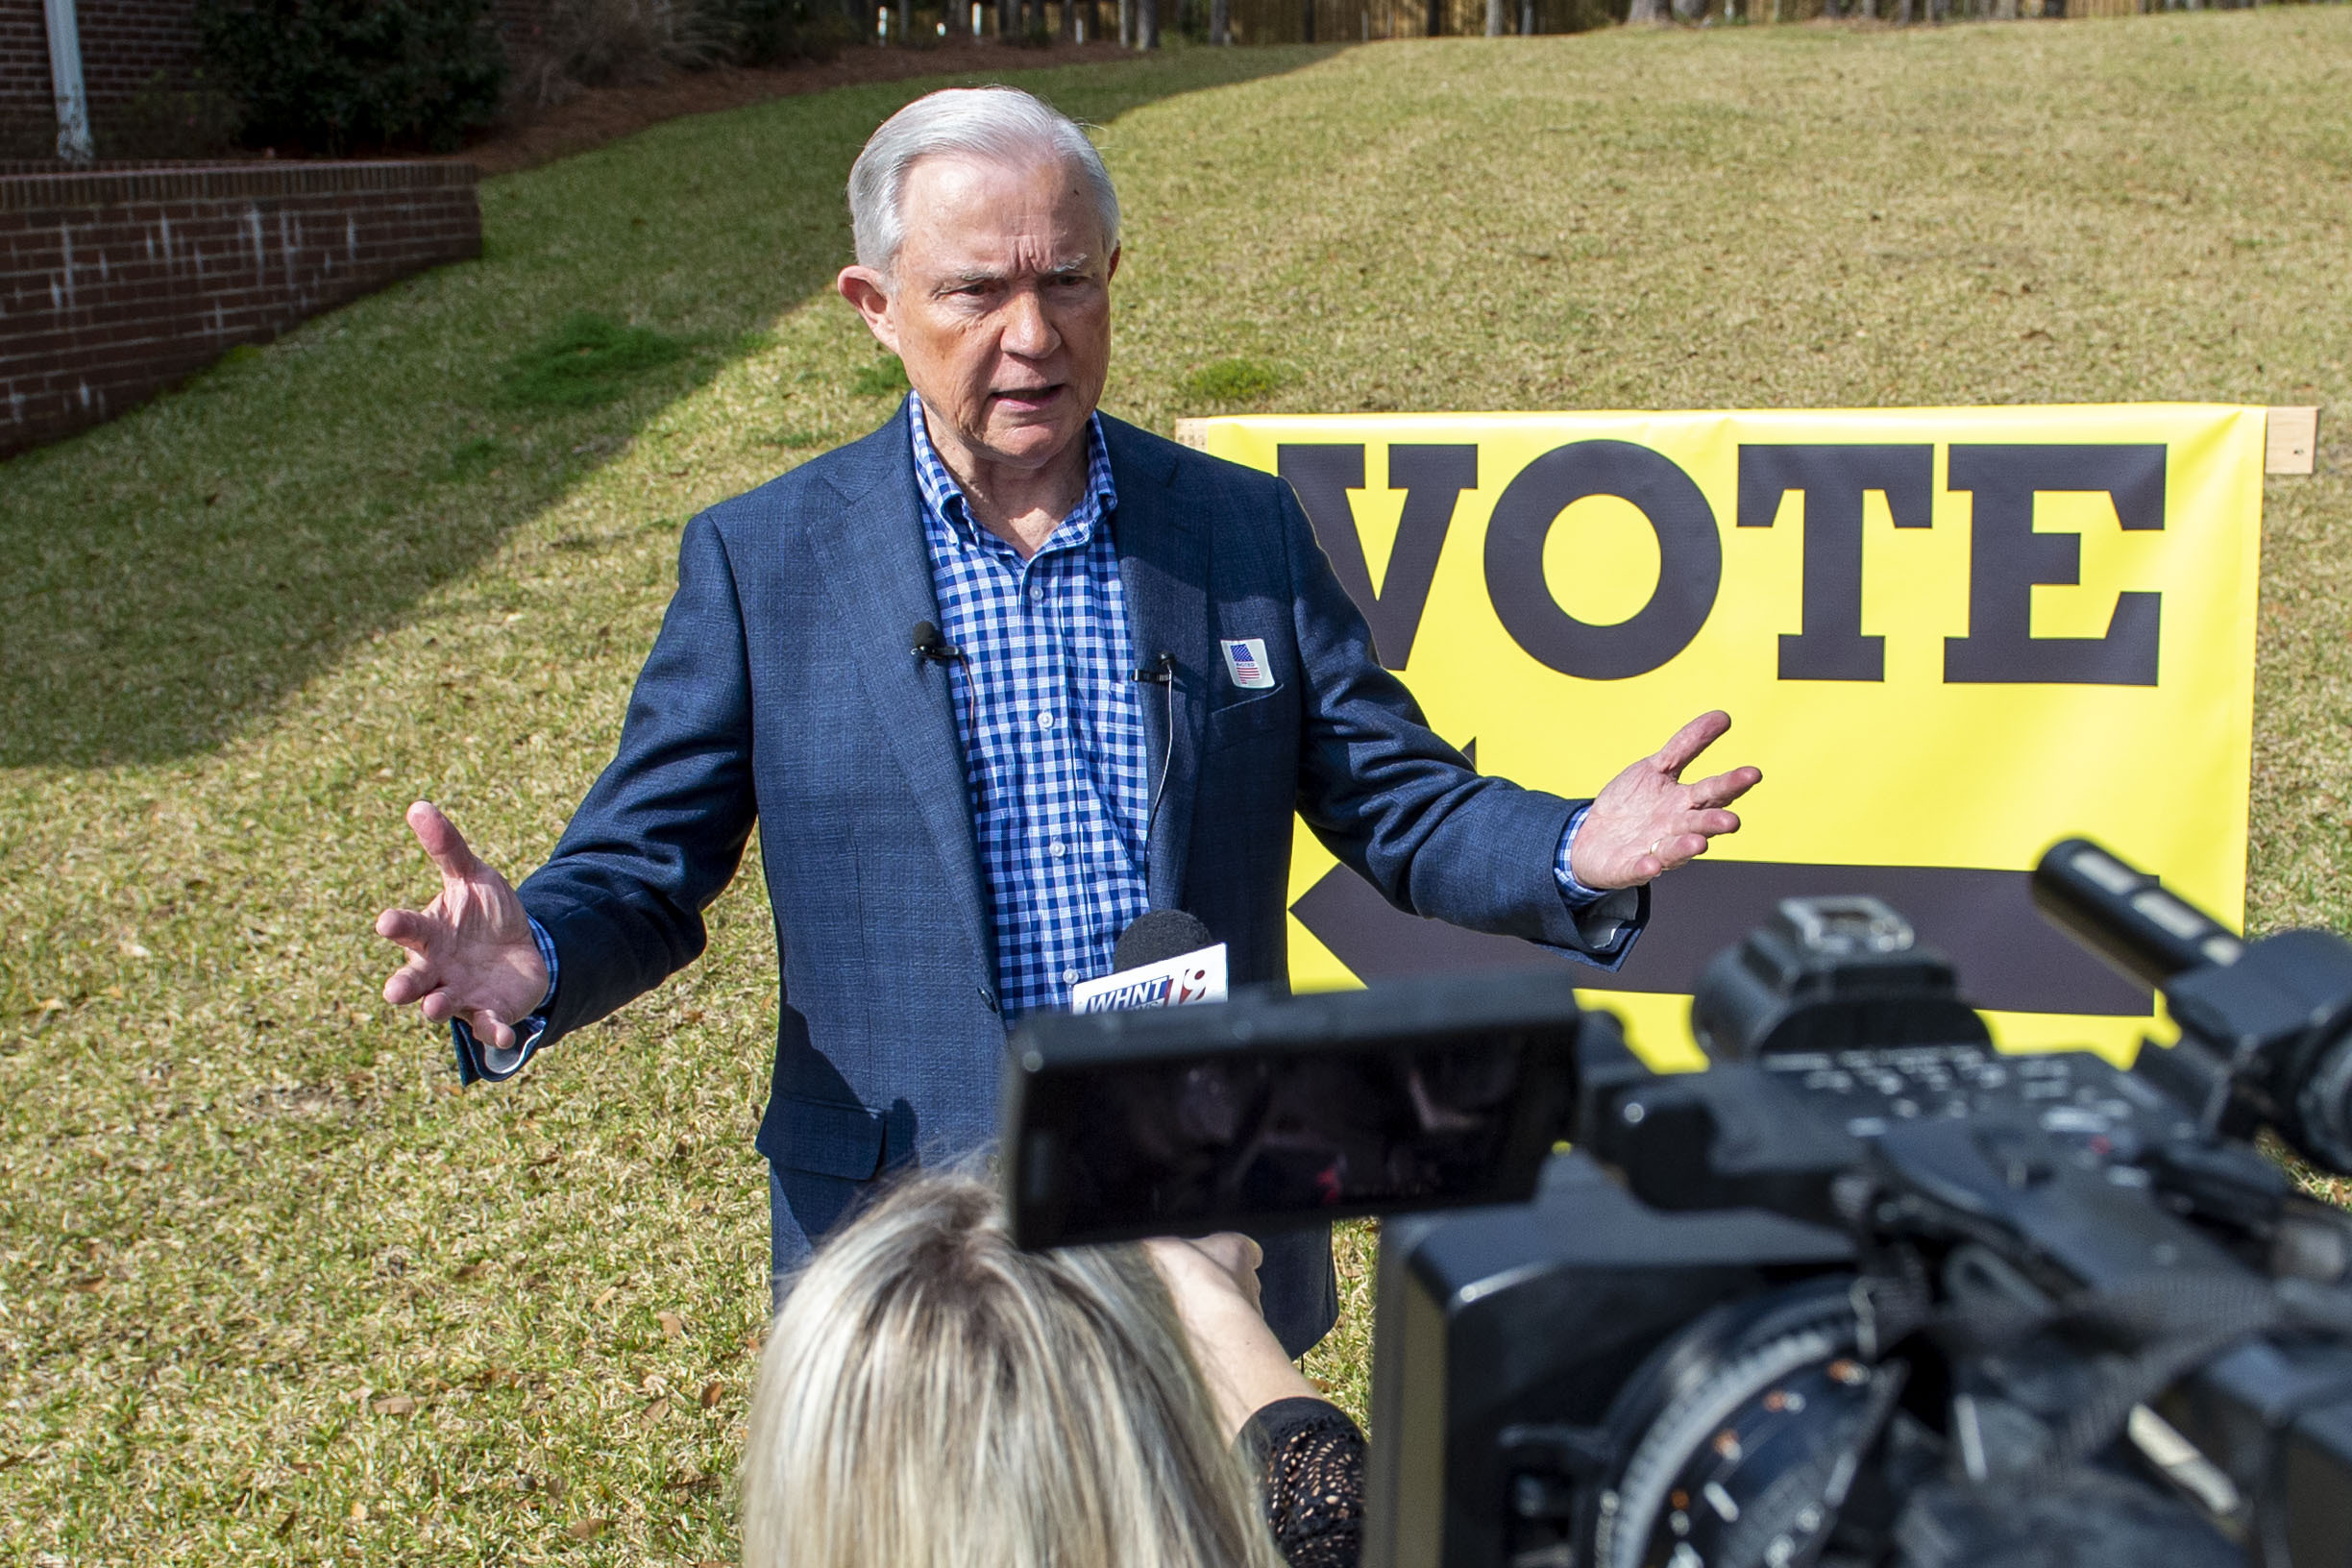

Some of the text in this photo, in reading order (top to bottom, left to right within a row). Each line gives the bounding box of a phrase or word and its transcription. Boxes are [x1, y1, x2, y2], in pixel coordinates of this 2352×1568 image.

[1276, 438, 2168, 685] VOTE
[1089, 967, 1209, 1013] WHNT 19
